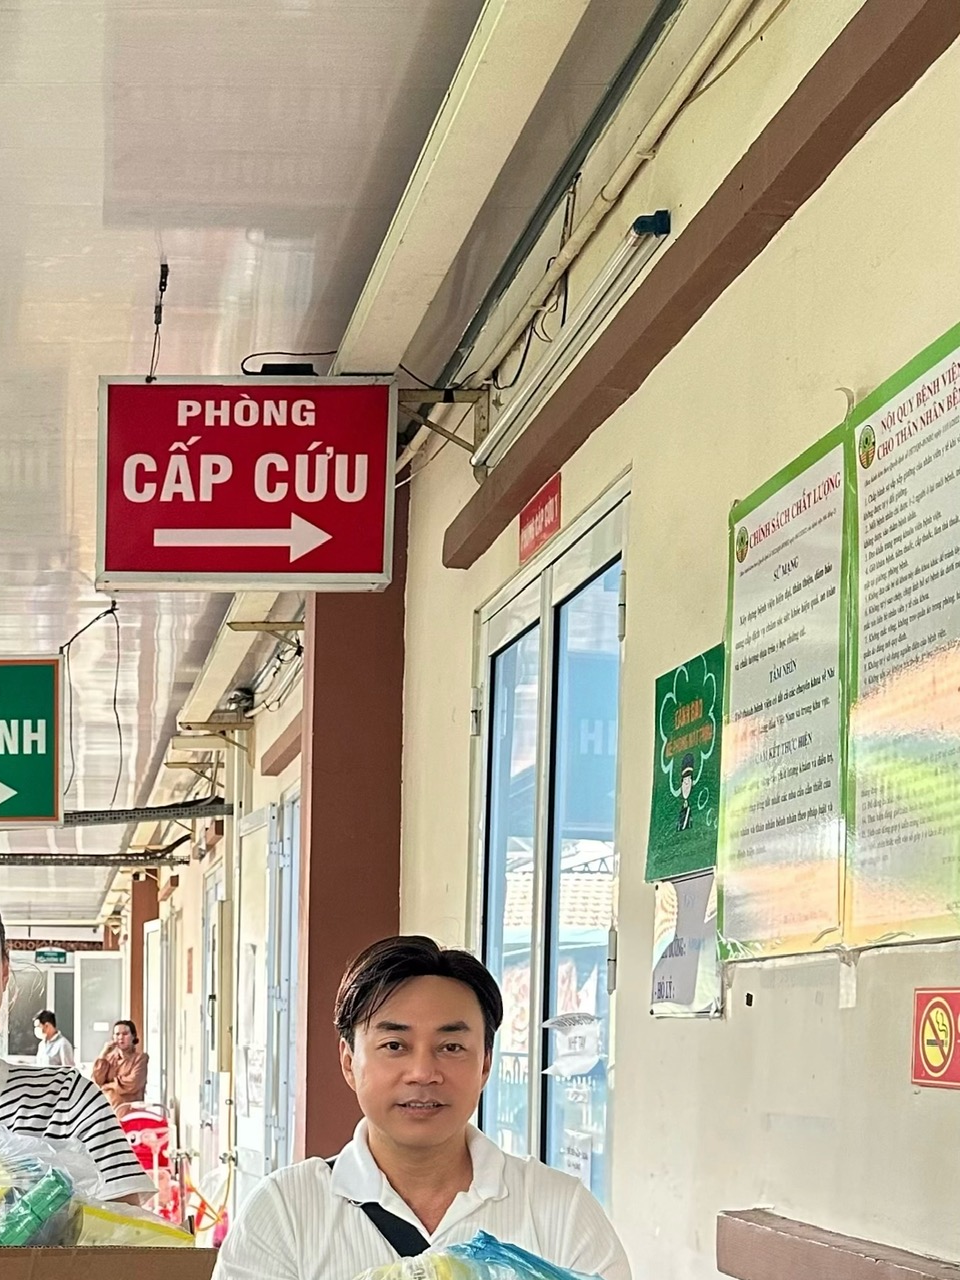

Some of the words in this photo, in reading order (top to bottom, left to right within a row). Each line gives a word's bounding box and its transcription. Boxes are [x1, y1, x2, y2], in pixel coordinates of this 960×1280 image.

[177, 393, 316, 427] PHÒNG
[122, 435, 233, 503] CẤP
[253, 441, 369, 503] CỨU
